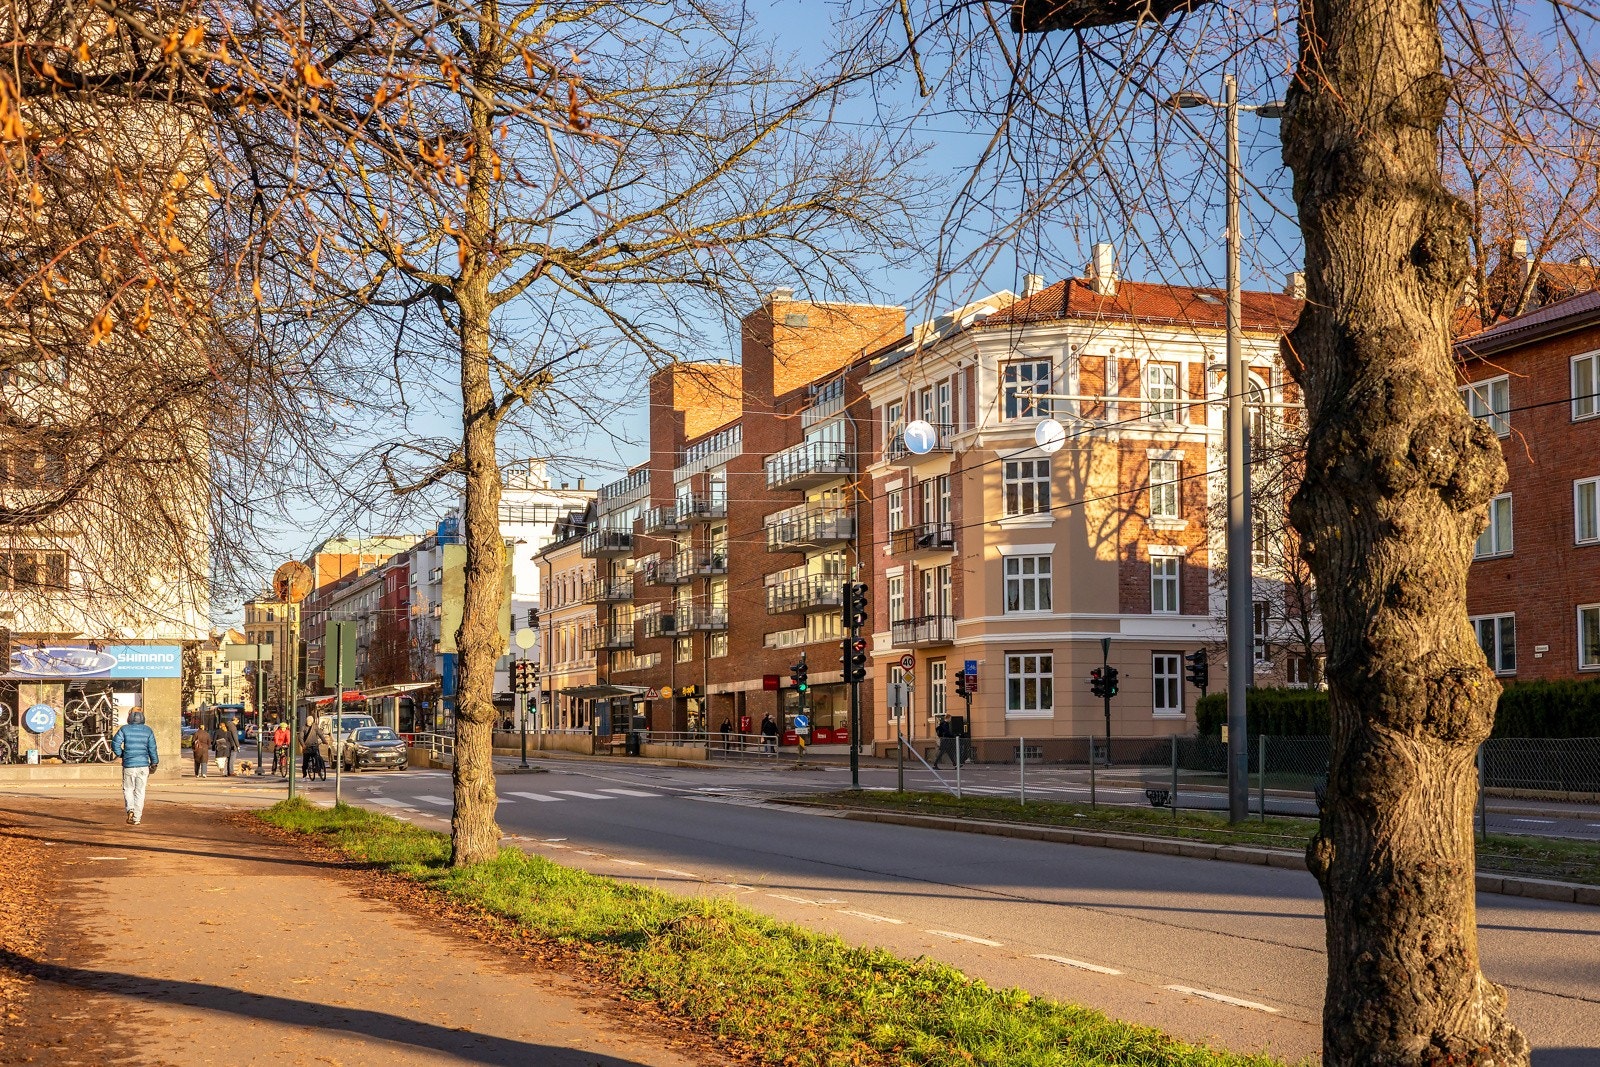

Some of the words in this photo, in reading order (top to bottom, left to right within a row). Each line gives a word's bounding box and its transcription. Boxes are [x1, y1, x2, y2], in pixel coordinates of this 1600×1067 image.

[117, 653, 174, 662] SHIMANO
[902, 657, 913, 666] 40
[30, 710, 50, 725] 40
